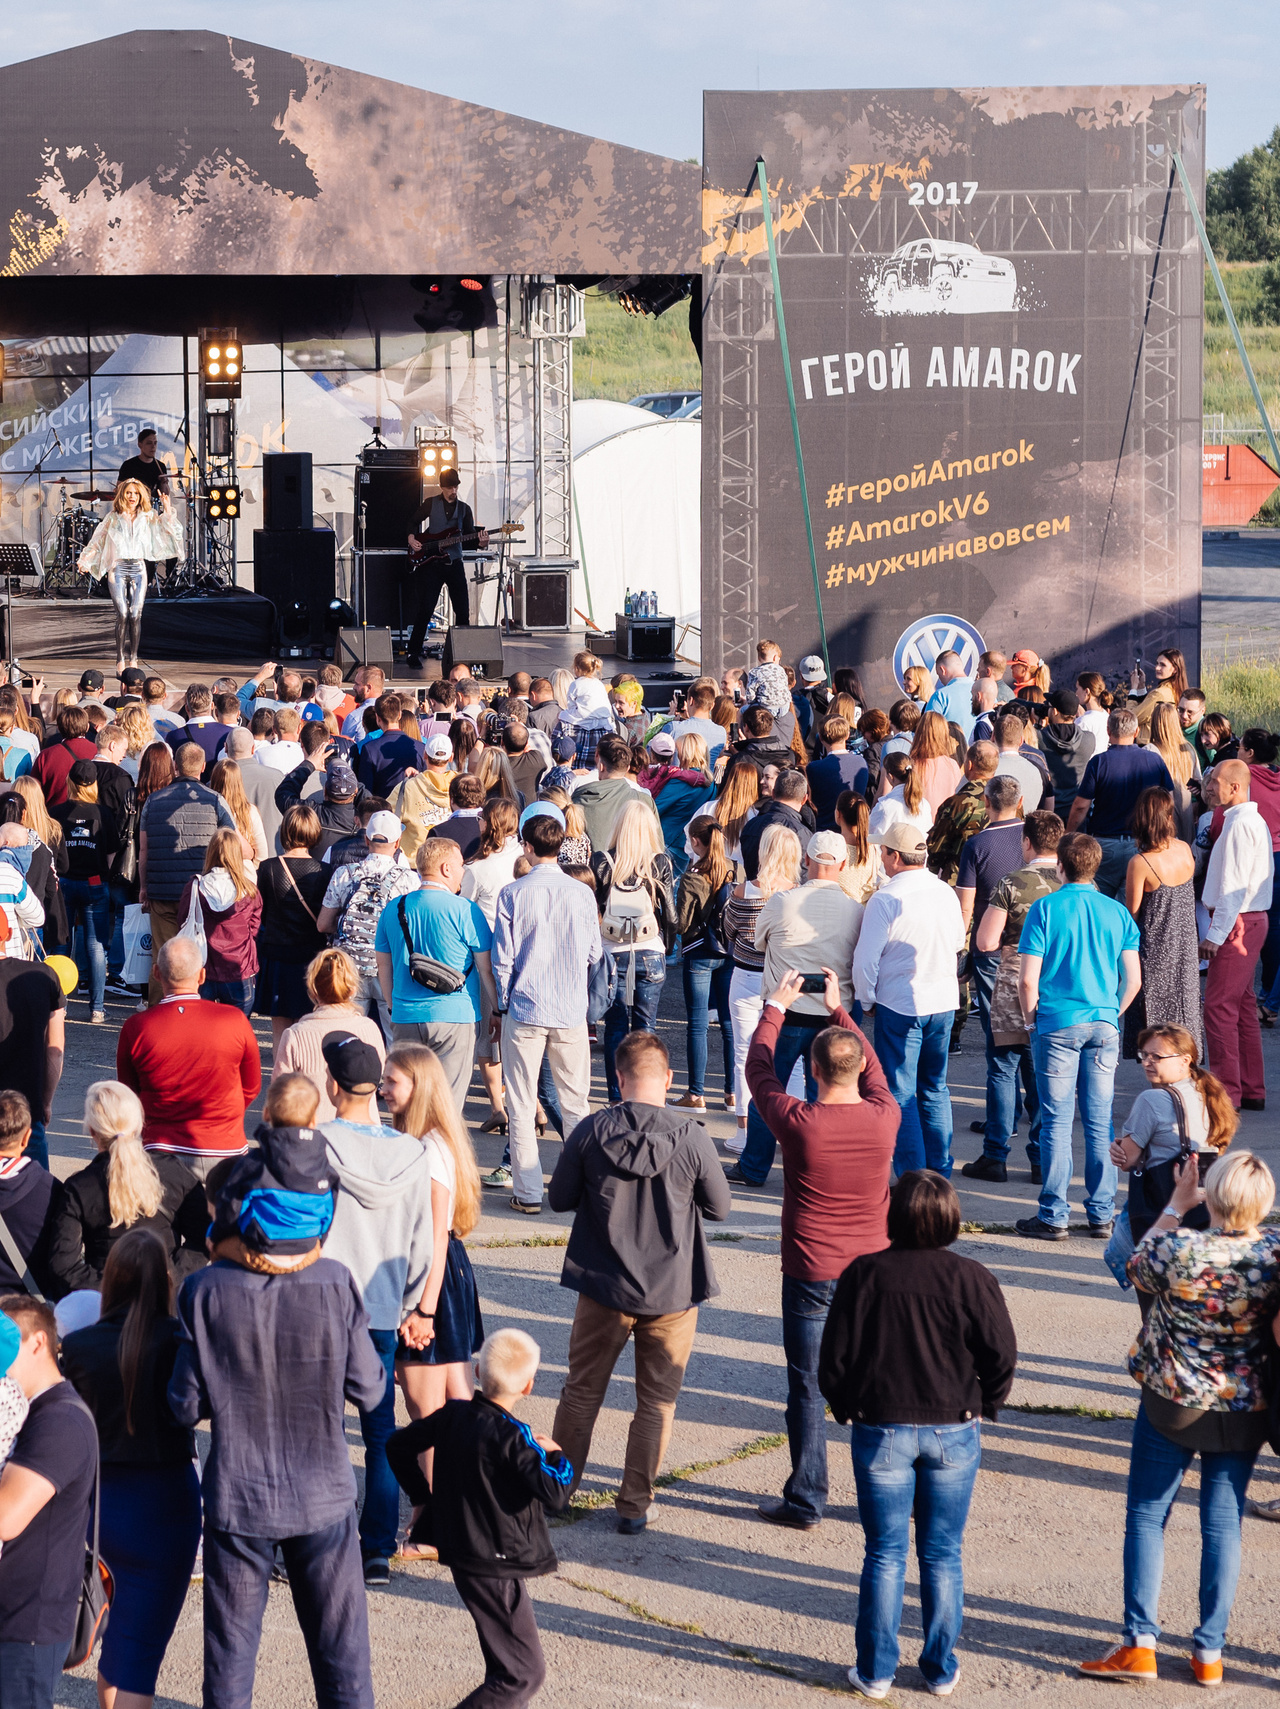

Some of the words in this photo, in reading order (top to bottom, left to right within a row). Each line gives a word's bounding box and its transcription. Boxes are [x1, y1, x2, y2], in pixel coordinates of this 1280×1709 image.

[908, 182, 979, 205] 2017
[801, 342, 911, 400] ГЕРОЙ
[926, 346, 1082, 395] AMAROK
[825, 439, 1035, 508] #геройAmarok
[825, 491, 990, 550] #AmarokV6
[825, 515, 1071, 589] #мужчинавовсем
